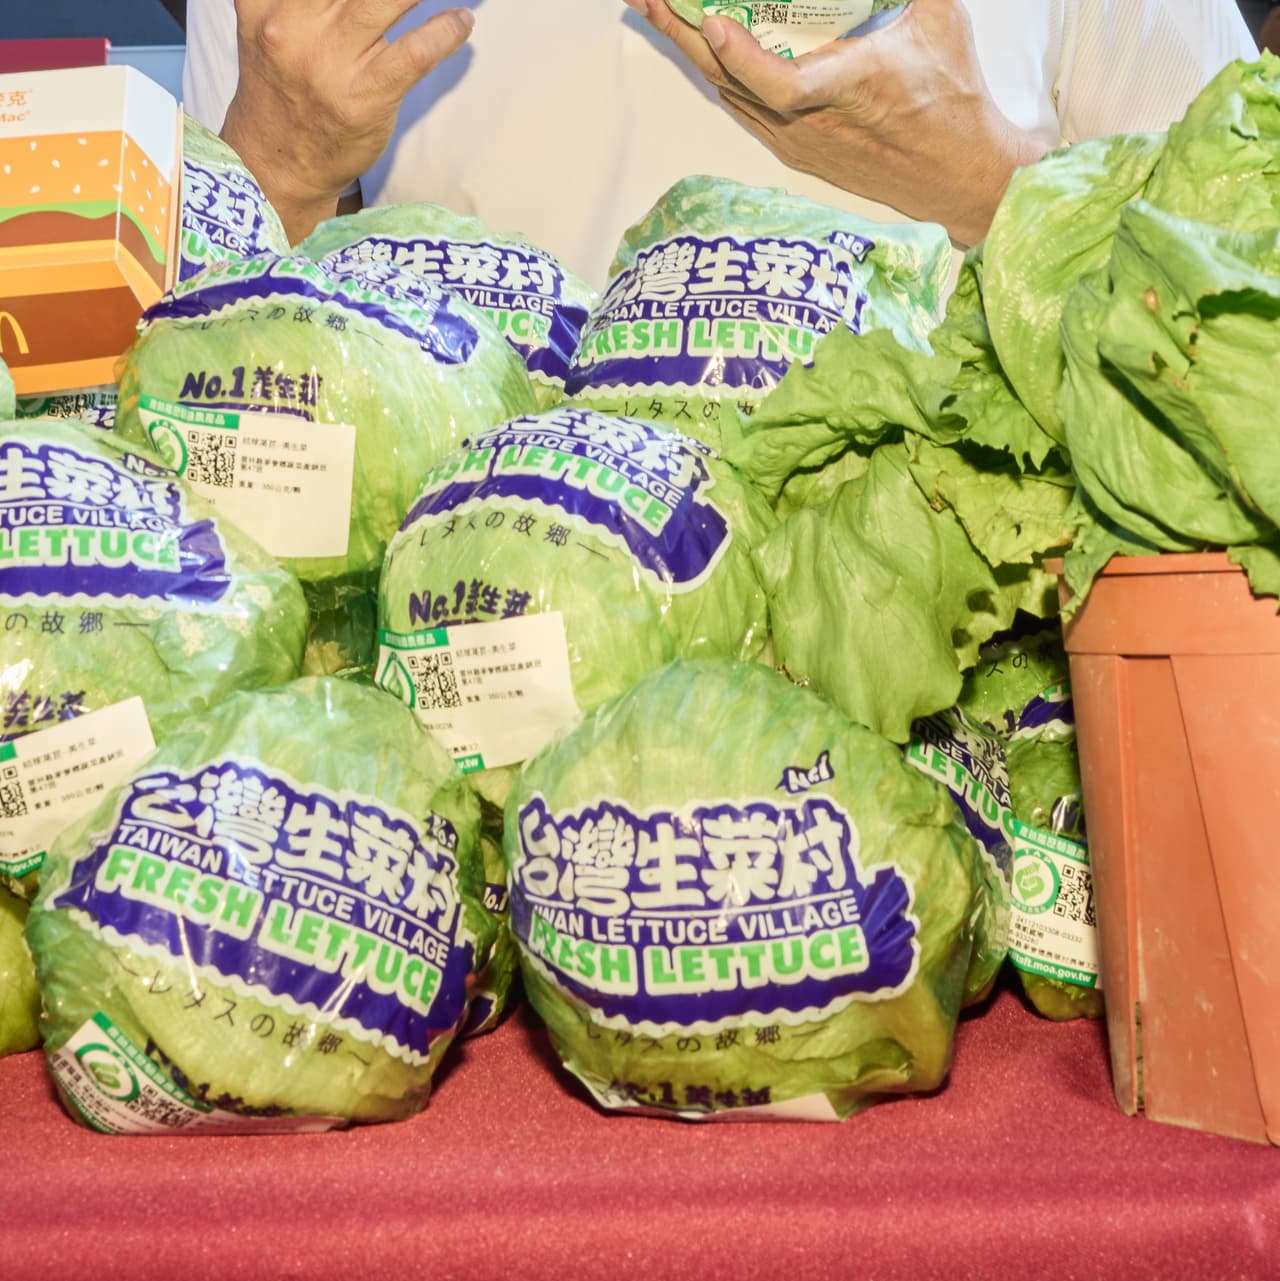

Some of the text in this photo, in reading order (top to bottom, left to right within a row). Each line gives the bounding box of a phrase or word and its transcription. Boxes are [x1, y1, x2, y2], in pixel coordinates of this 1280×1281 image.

[465, 288, 554, 316] VILLAGE
[651, 299, 757, 319] LETTUCE
[581, 320, 678, 359] FRESH
[692, 320, 814, 357] LETTU
[179, 366, 246, 399] No.1
[501, 444, 671, 529] LETTUCE
[584, 446, 683, 509] VILLAGE
[130, 770, 456, 934] 台灣生菜村
[521, 806, 845, 918] 台灣生菜村
[118, 823, 450, 968] TAIWAN LETTUCE VILLAGE
[590, 918, 729, 944] LETTUCE
[737, 897, 861, 940] VILLAGE
[104, 849, 442, 1006] FRESH LETTUCE
[650, 926, 865, 984] LETTUCE
